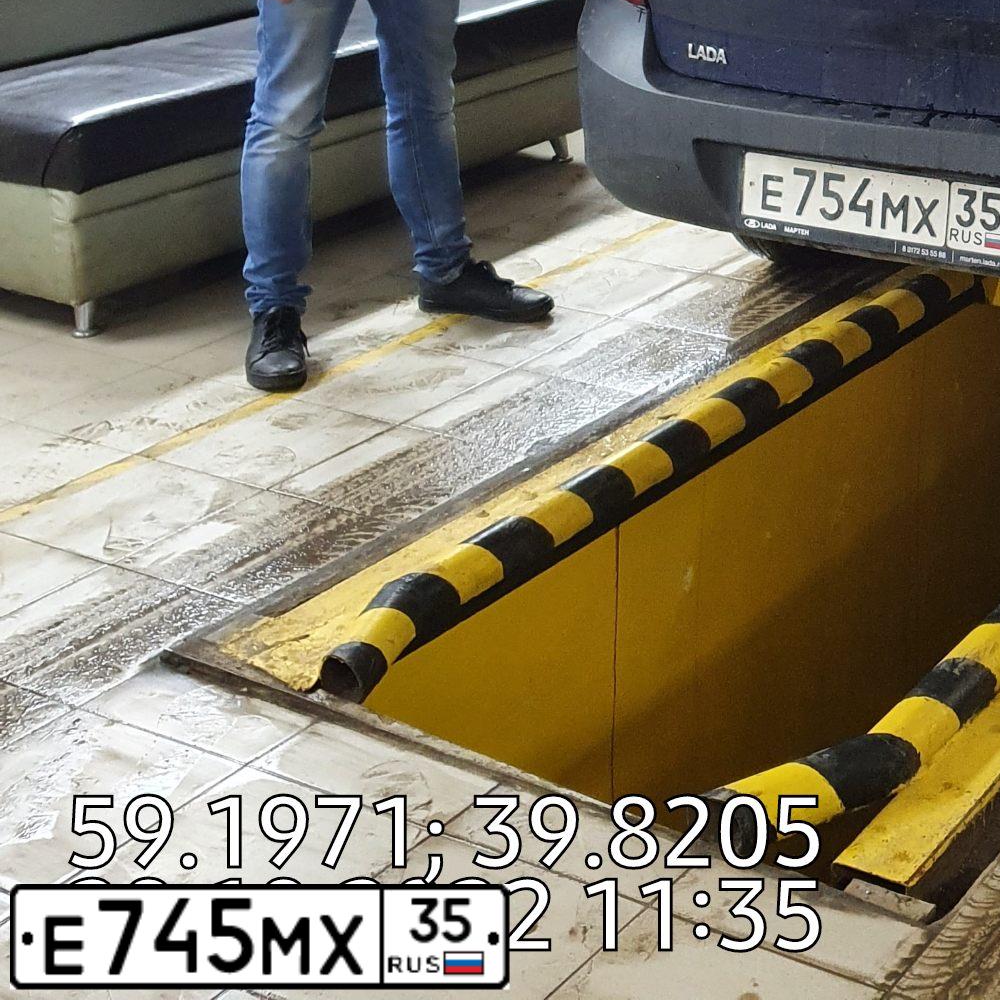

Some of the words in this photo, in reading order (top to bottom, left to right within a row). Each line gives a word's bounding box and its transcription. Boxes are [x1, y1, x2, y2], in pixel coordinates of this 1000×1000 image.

[687, 42, 728, 65] LADA
[760, 221, 777, 231] LADA
[949, 228, 983, 246] RUS
